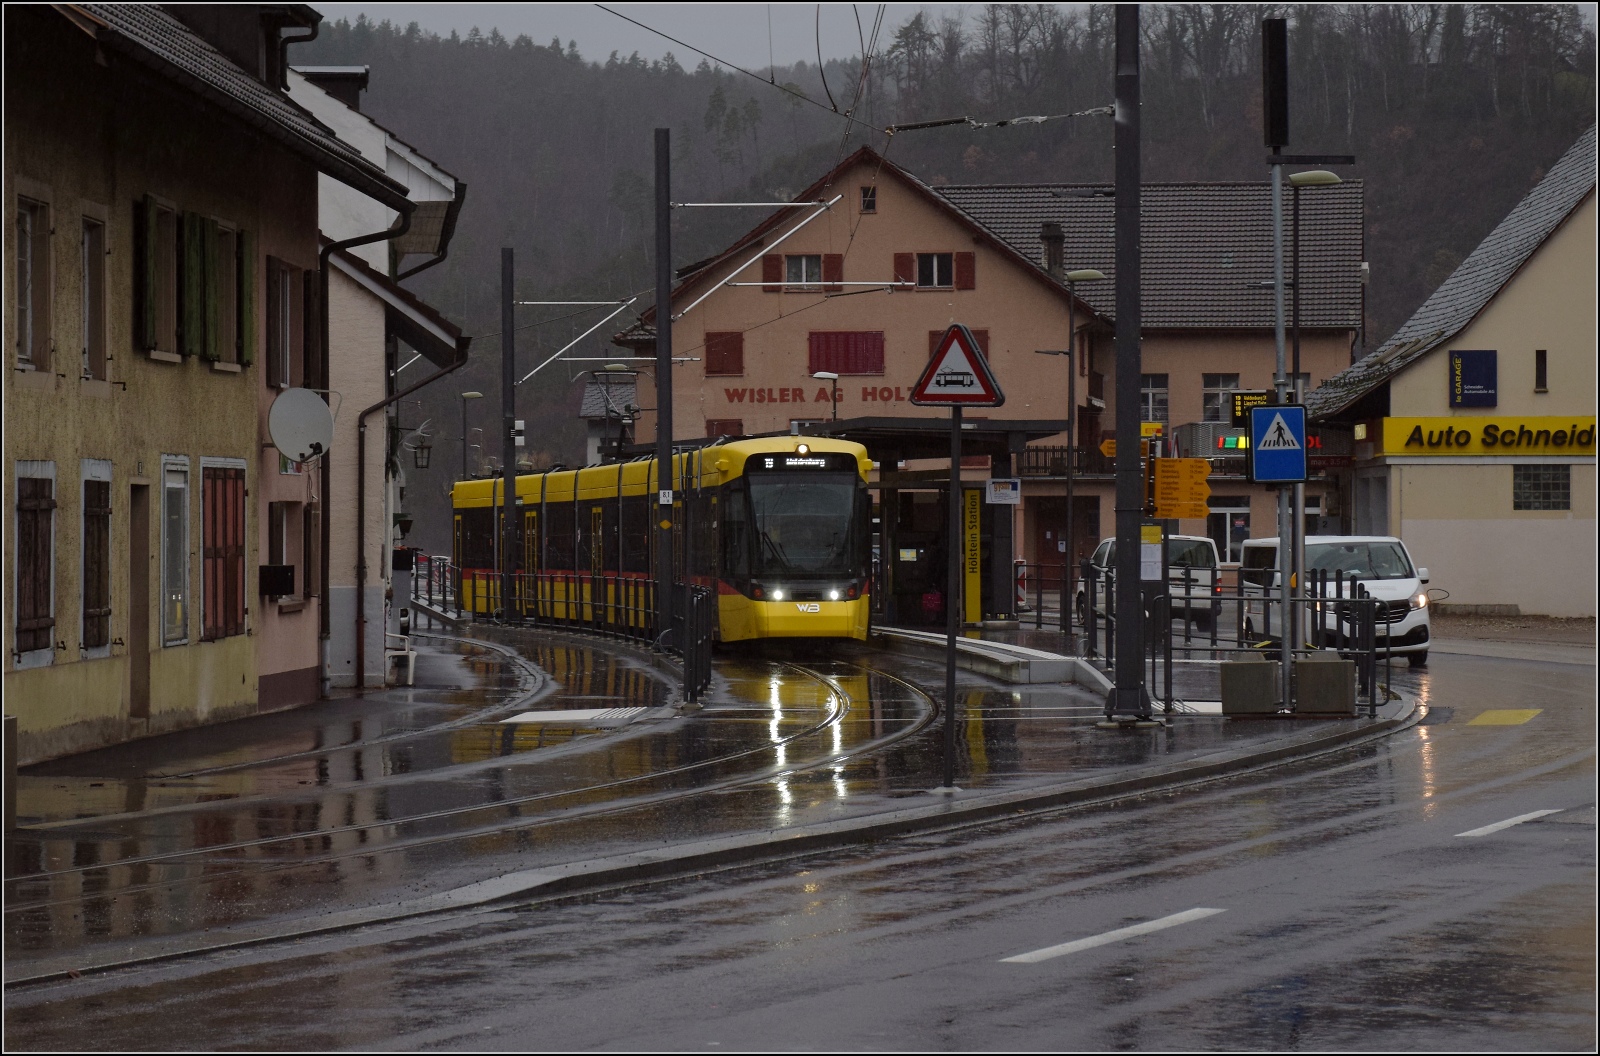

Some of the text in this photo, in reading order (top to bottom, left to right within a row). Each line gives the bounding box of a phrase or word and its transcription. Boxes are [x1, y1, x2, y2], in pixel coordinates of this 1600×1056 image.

[724, 387, 806, 403] WISLER
[814, 387, 844, 403] AG
[1404, 423, 1596, 447] Auto Schneid
[968, 494, 978, 574] Hölstein Station
